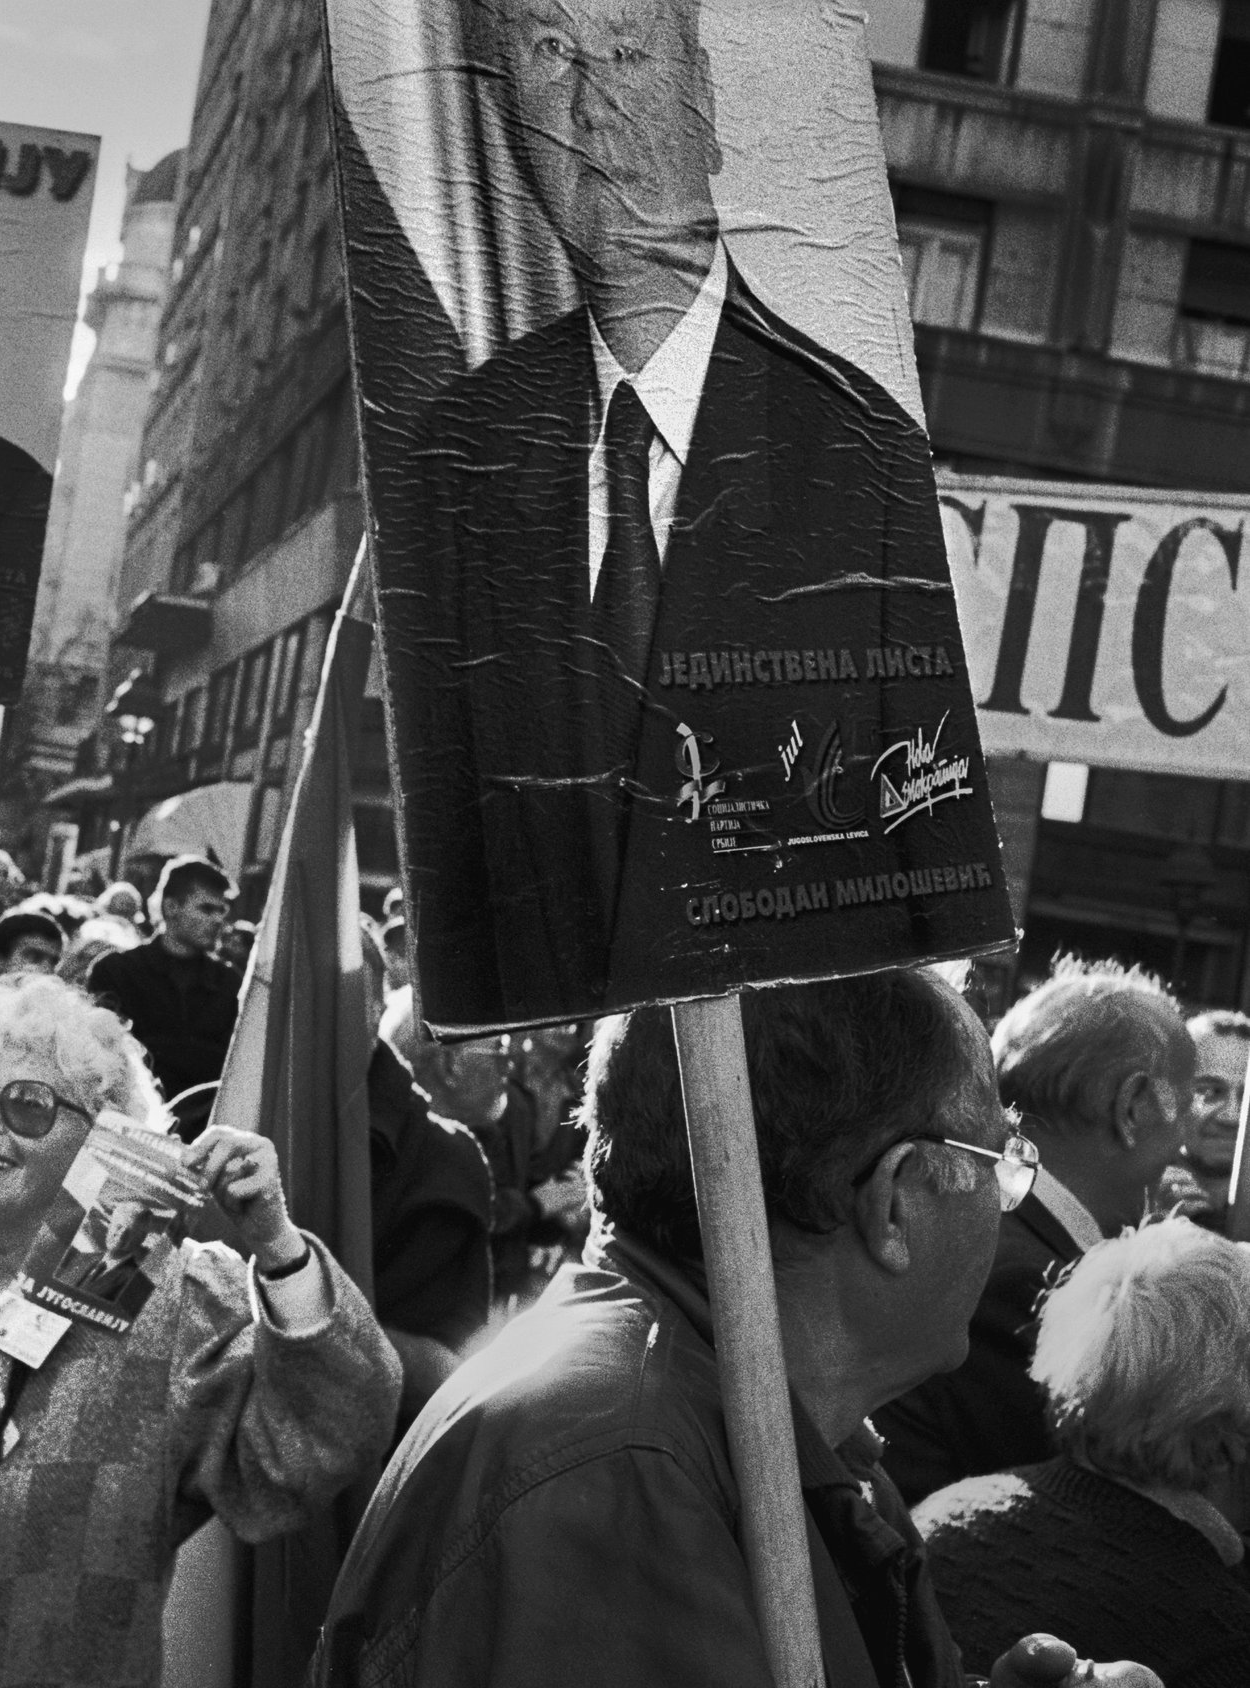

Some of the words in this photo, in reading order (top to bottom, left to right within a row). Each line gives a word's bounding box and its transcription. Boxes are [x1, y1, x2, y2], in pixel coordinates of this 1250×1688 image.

[938, 494, 1244, 738] ПС
[658, 649, 858, 690] ЈЕДИНСТВЕНА
[866, 646, 954, 680] ЛИСТА
[778, 719, 803, 782] jul
[707, 800, 770, 815] СОЦИЈАЛИСТИЧКА
[710, 819, 741, 832] ПАРТИЈА
[787, 832, 845, 846] JUGOSLOVENSKA
[846, 829, 870, 840] LEVICA
[711, 836, 737, 850] СРБИЈЕ
[686, 881, 830, 926] СЛОБОДАН
[835, 862, 993, 906] МИЛОШЕВИЋ
